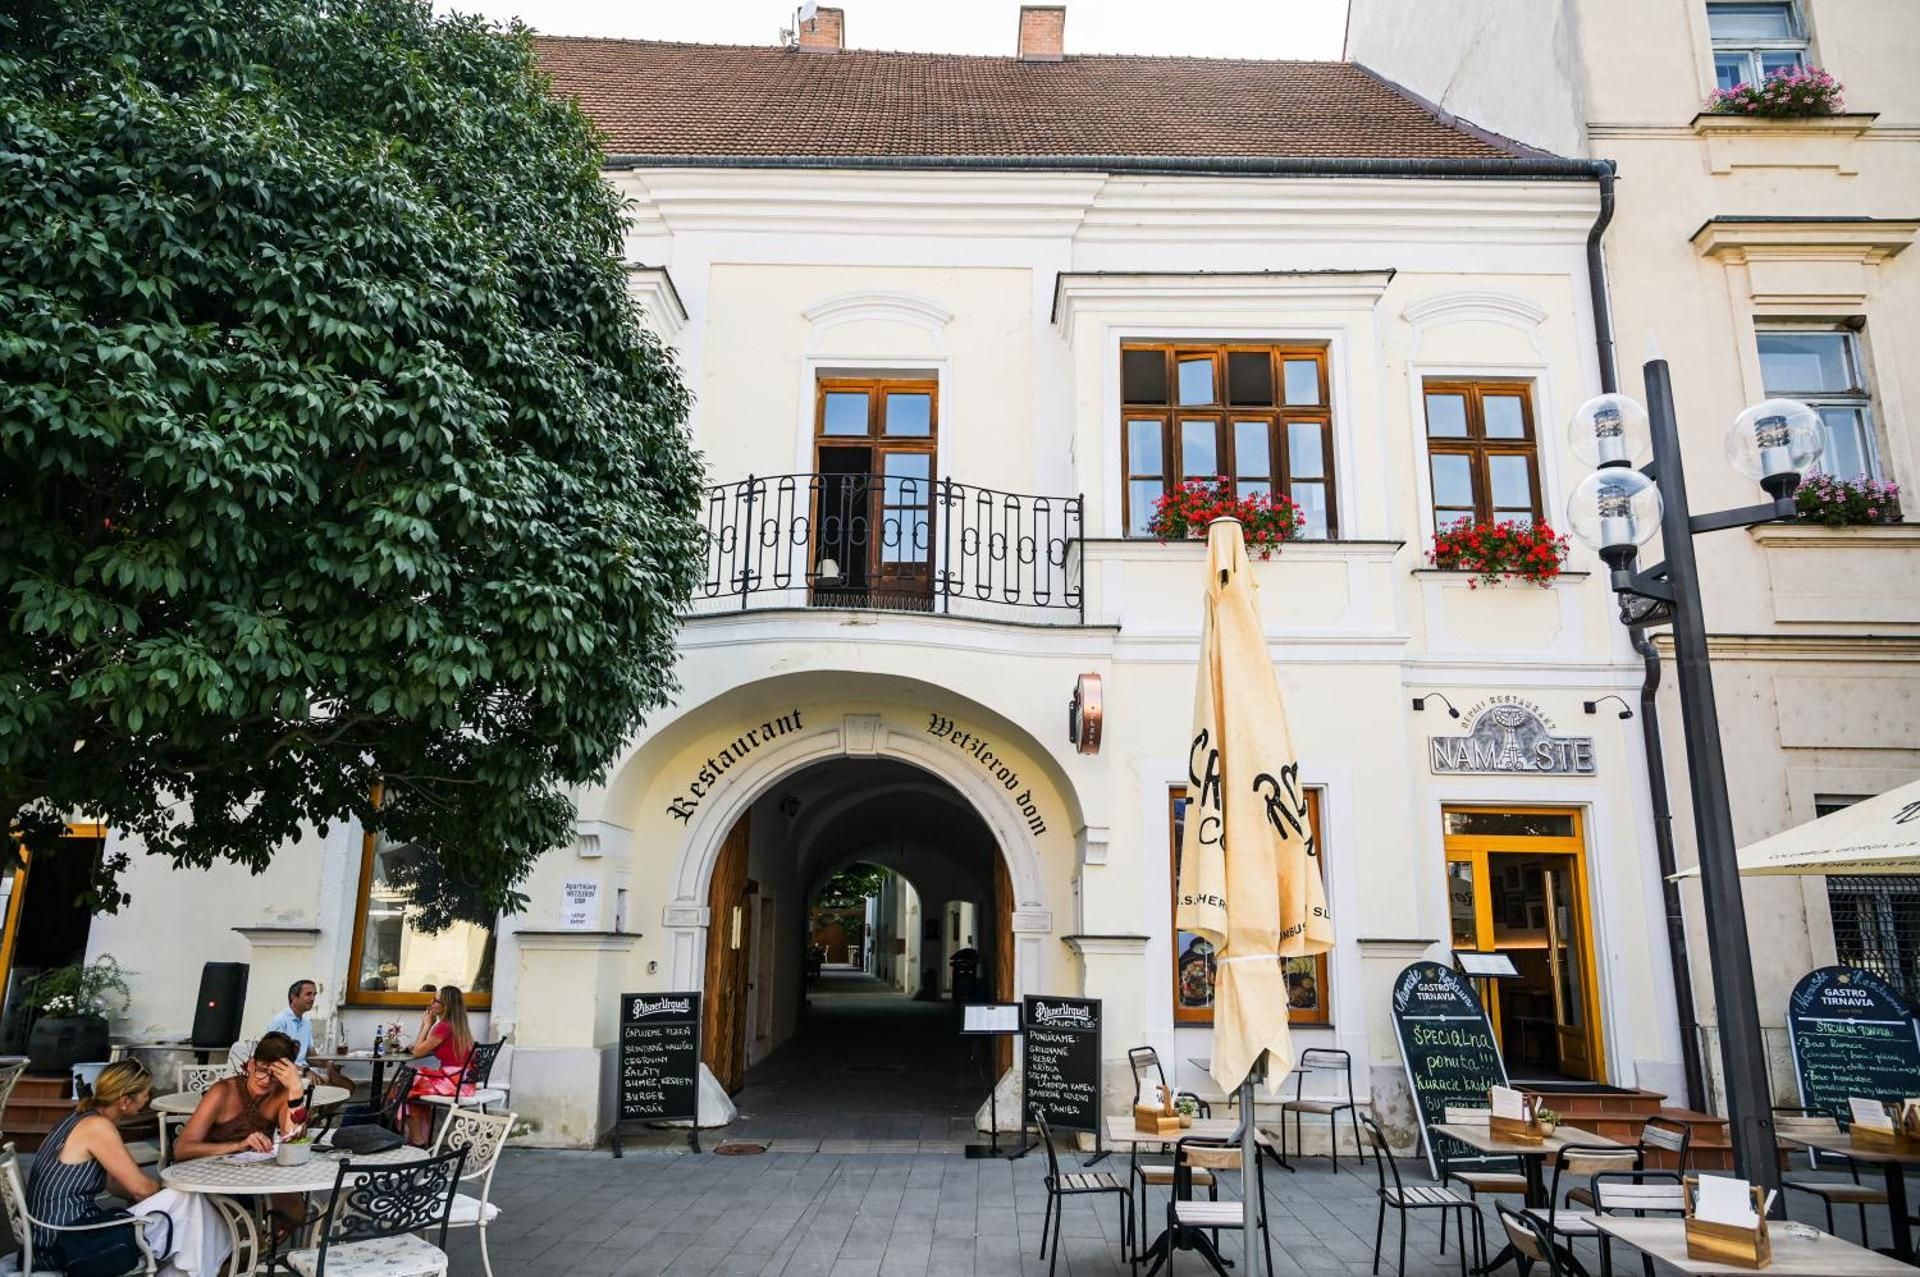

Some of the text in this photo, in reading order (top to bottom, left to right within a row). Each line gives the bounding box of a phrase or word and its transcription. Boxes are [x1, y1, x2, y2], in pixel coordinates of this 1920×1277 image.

[666, 708, 803, 826] Restaurant
[928, 713, 1048, 836] Wetzlerov dom
[1417, 983, 1450, 992] GASTRO
[1824, 987, 1867, 998] GASTRO
[1416, 992, 1457, 1001] TIRNAVIA
[1820, 996, 1875, 1007] TIRNAVIA
[633, 997, 691, 1019] Pilsner Urquell
[1035, 1001, 1063, 1023] Pilsner
[624, 1091, 666, 1102] BURGER
